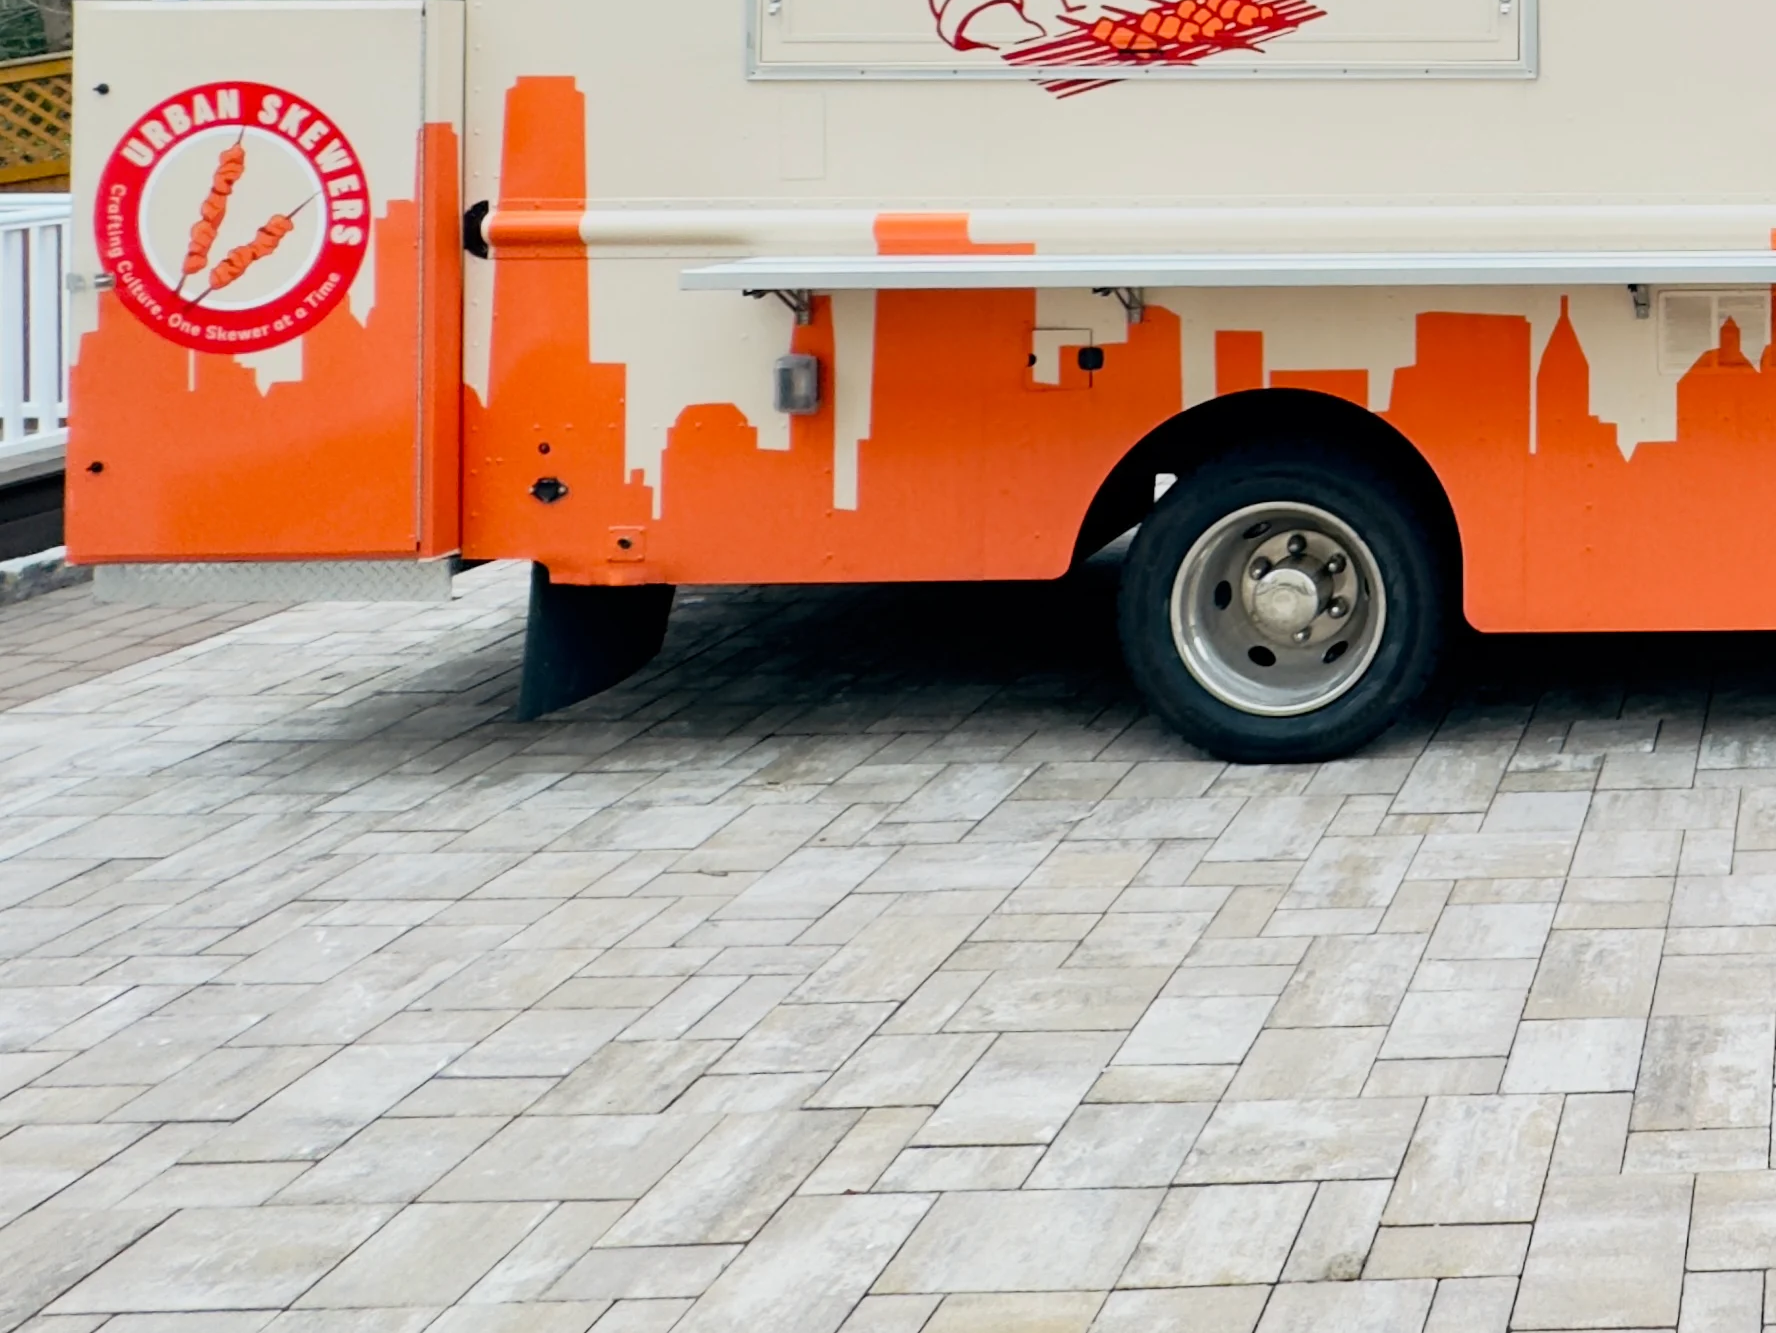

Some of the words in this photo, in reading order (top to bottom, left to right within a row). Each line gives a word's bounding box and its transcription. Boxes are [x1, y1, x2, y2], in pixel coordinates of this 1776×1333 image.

[120, 89, 240, 168] URBAN
[257, 94, 365, 247] SKEWERS
[106, 184, 127, 258] Crafting
[116, 260, 164, 321] Culture,
[304, 271, 341, 310] Time
[168, 313, 201, 337] One
[274, 314, 293, 332] at
[295, 306, 308, 320] a
[205, 324, 269, 341] Skewer
